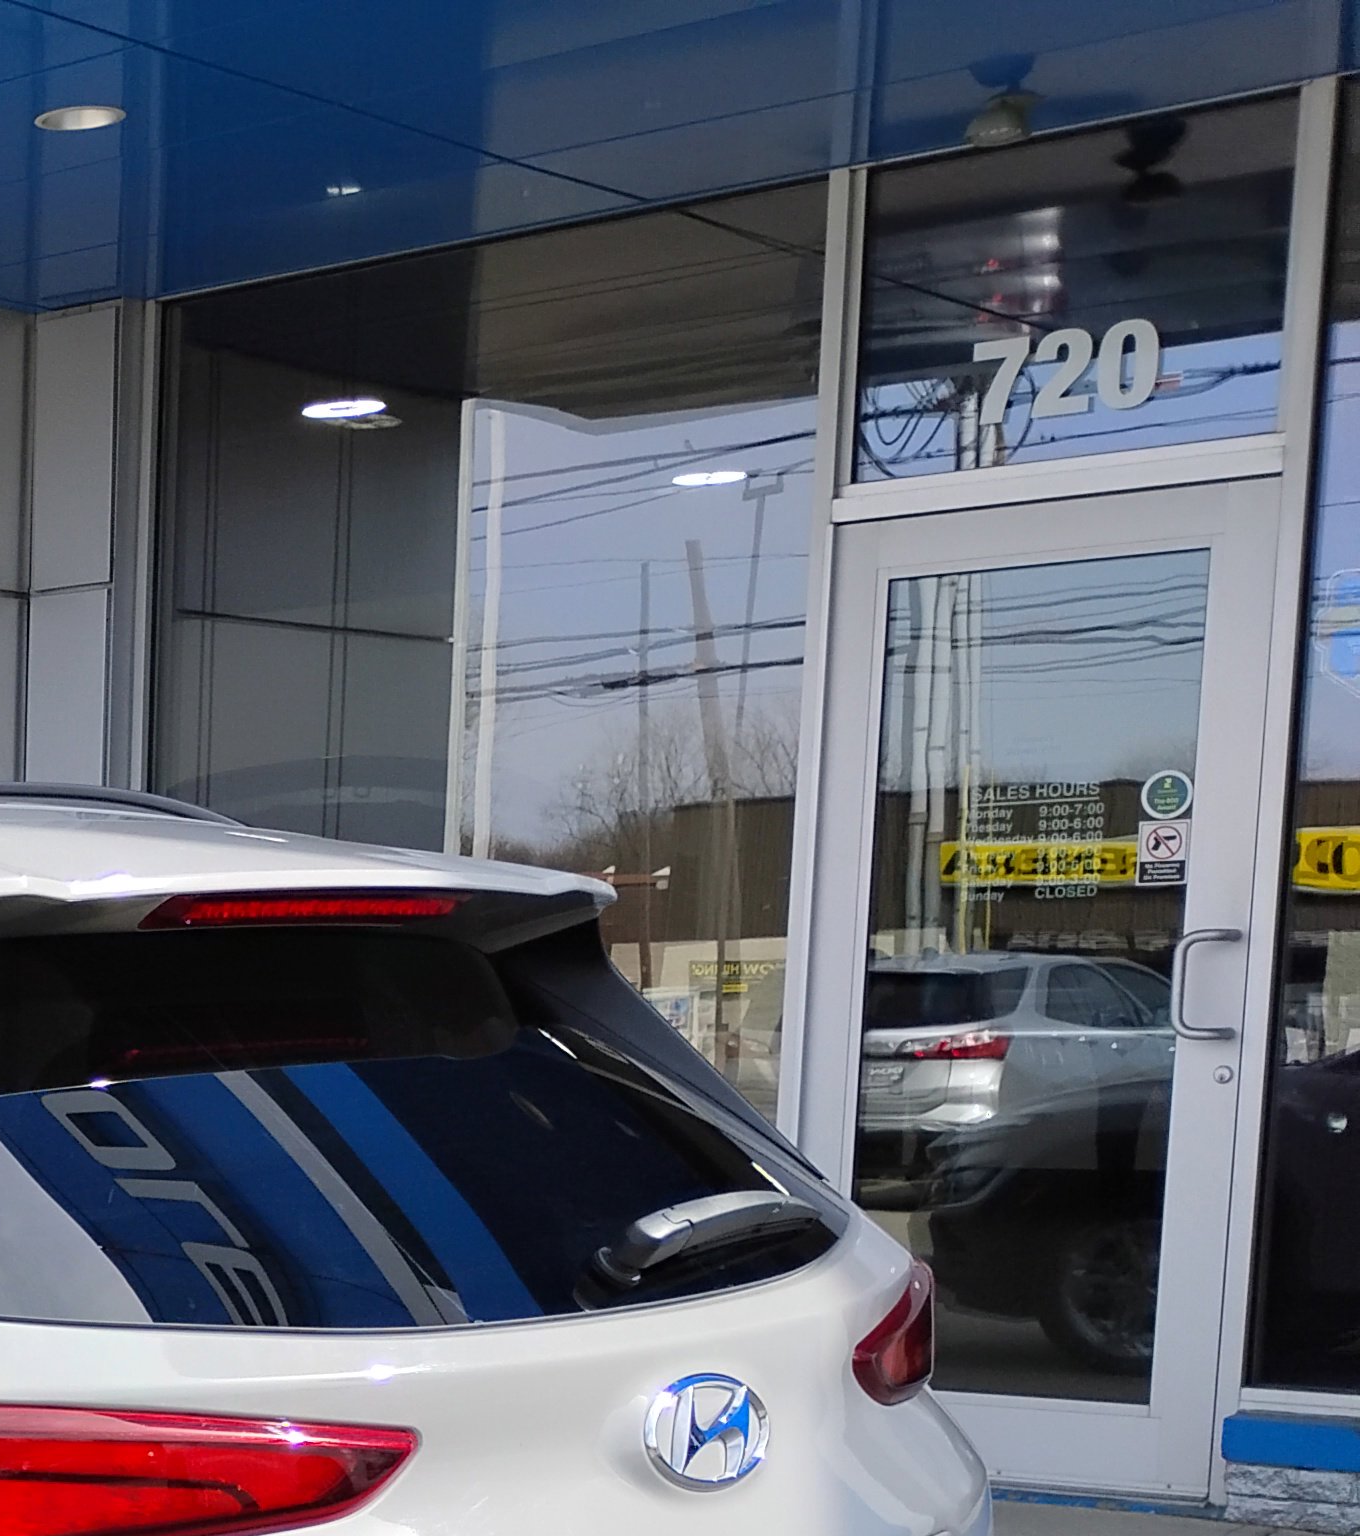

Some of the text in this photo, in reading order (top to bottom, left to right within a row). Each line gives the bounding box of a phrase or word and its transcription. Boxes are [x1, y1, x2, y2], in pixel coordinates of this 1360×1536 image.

[972, 318, 1160, 426] 720
[971, 781, 1100, 803] SALES HOURS
[1039, 802, 1105, 817] 9:00-7:00
[1038, 817, 1104, 831] 9:00-6:00
[1034, 885, 1098, 900] CLOSED
